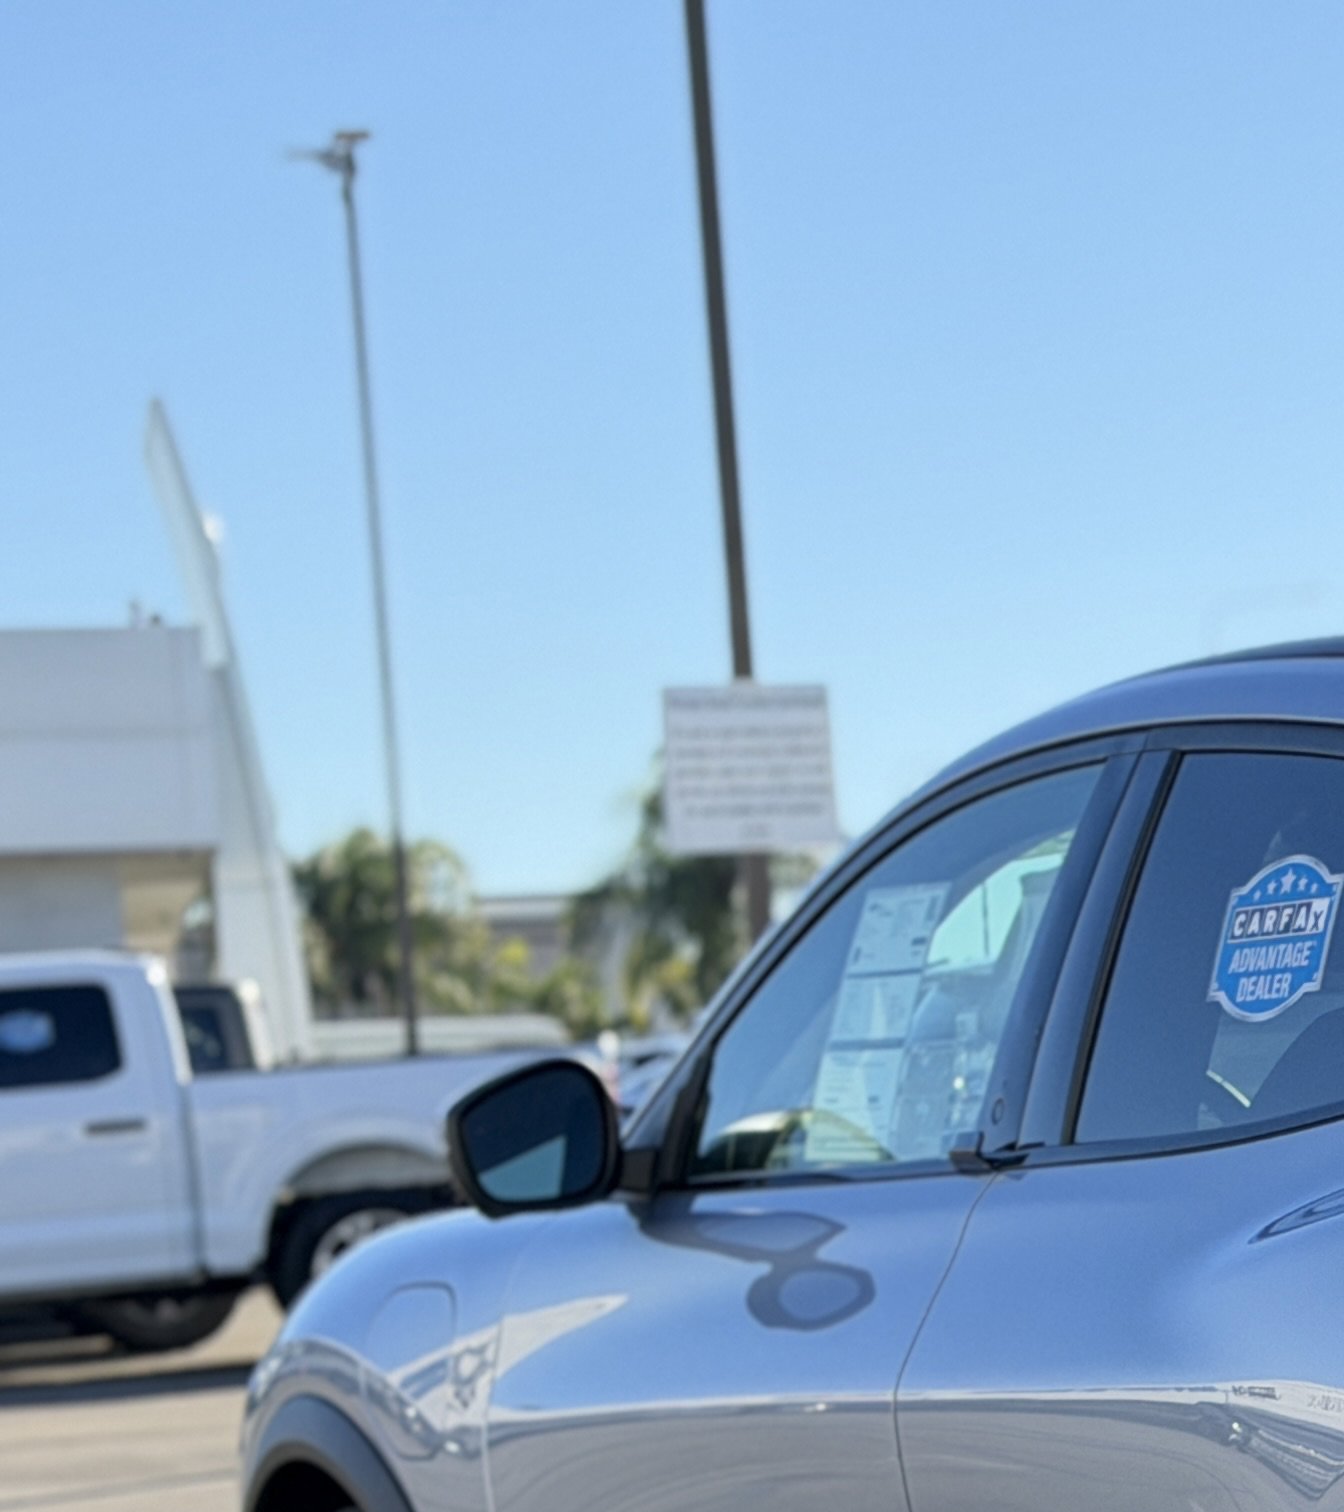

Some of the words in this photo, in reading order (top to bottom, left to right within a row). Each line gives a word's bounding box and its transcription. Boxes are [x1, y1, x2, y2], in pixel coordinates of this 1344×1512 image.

[1232, 904, 1324, 937] CARFAX
[1228, 940, 1313, 974] ADVANTAGE
[1235, 972, 1292, 1003] DEALER
